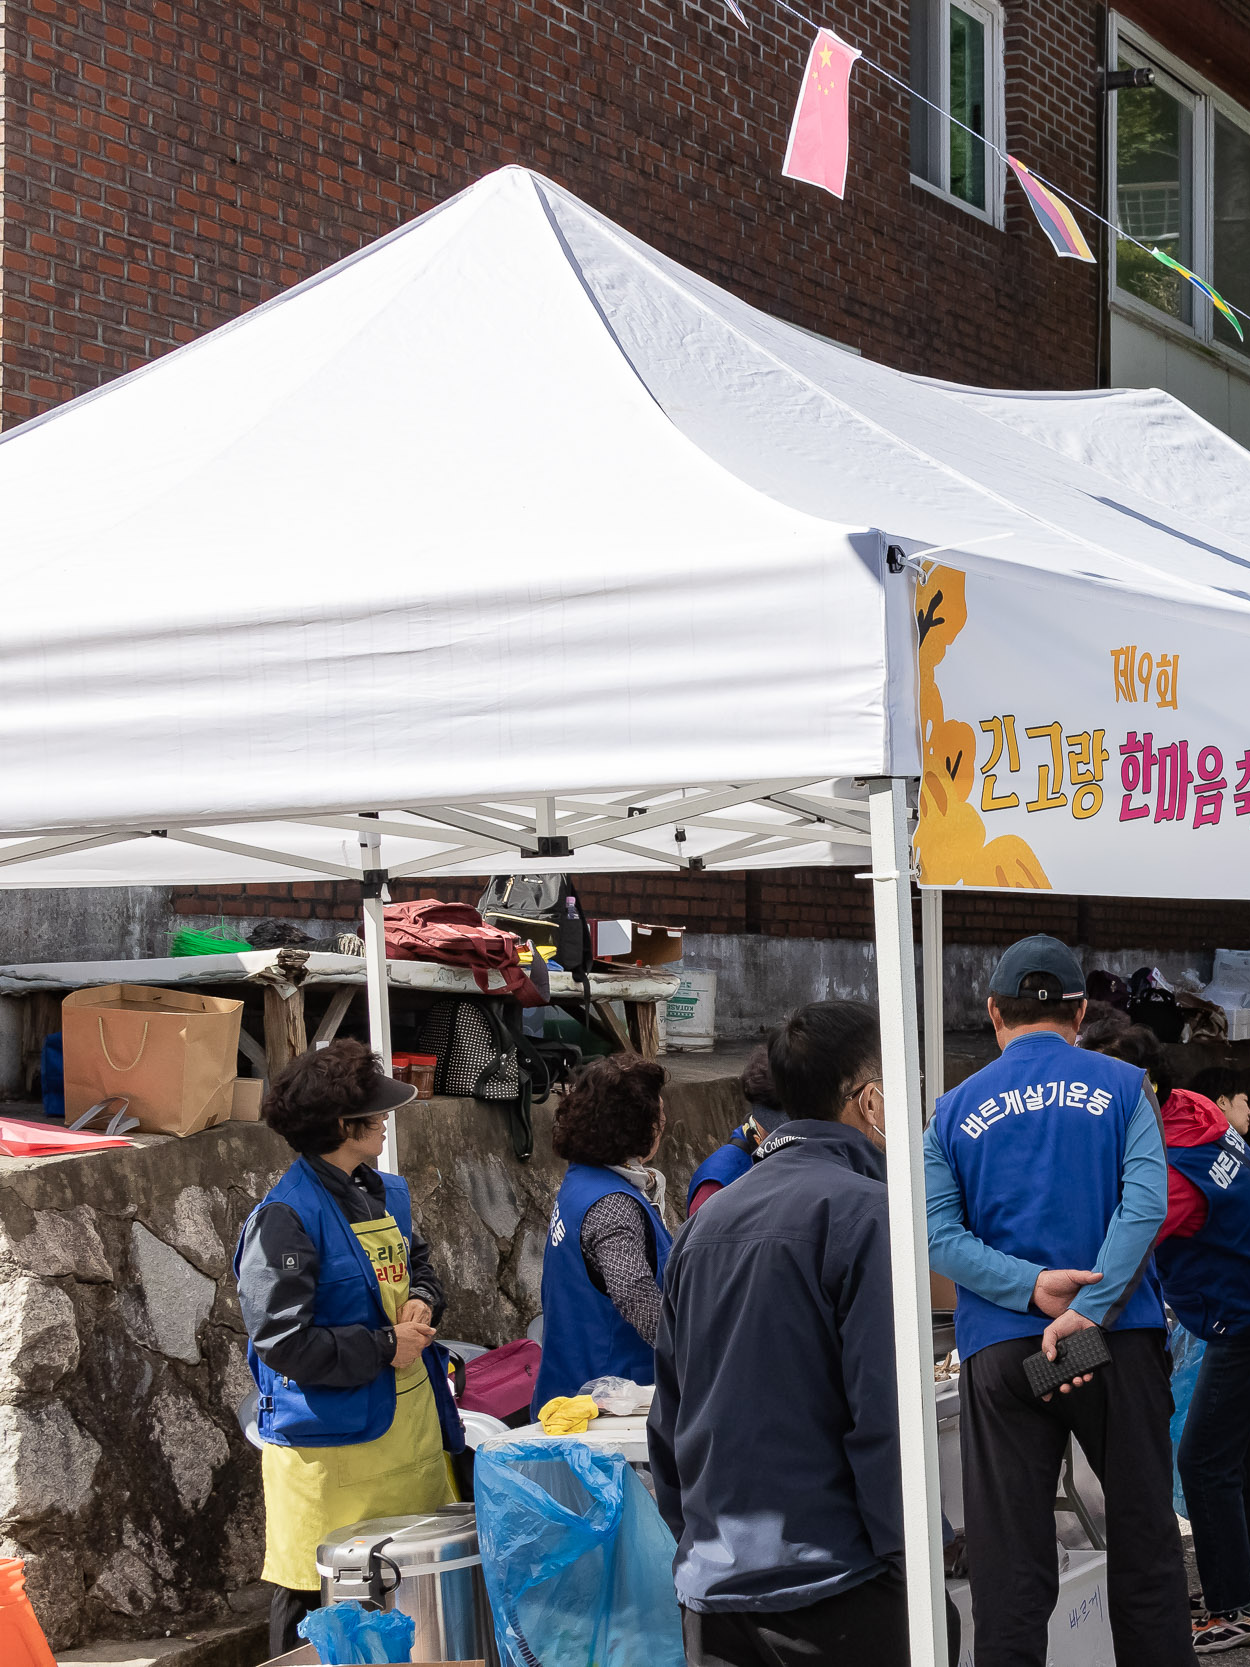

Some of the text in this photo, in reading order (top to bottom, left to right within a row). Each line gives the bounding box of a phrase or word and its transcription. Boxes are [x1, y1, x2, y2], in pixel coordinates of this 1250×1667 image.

[1111, 645, 1180, 710] 제9회
[979, 715, 1110, 820] 긴고랑
[1118, 731, 1228, 830] 한마음
[960, 1080, 1113, 1140] 바르게살기운동
